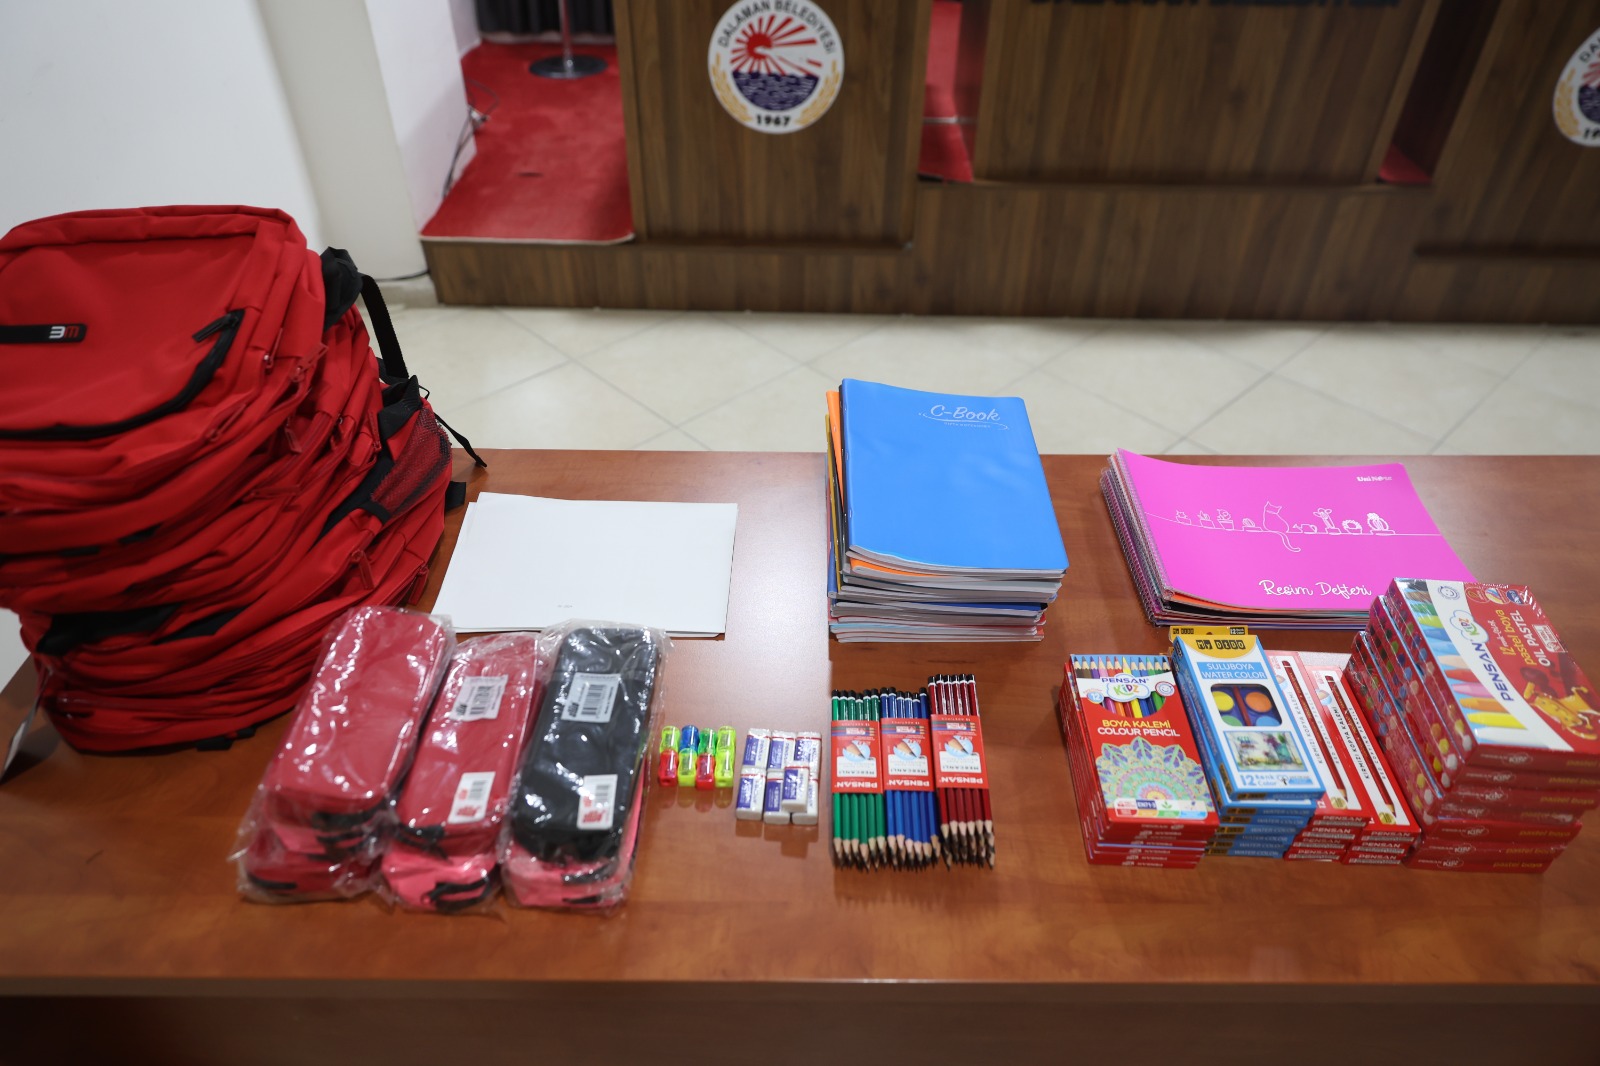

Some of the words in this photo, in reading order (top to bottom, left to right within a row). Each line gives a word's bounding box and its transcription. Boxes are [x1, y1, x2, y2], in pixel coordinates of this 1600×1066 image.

[718, 1, 771, 48] DALAMAN
[757, 115, 791, 126] 1967
[930, 404, 1001, 421] C-Book
[1259, 579, 1313, 596] Resim
[1315, 581, 1372, 599] Defteri
[1495, 608, 1516, 633] boya
[1509, 609, 1540, 647] PASTEL
[1507, 633, 1538, 666] pastel
[1533, 648, 1551, 667] OIL
[1202, 671, 1233, 679] WATER
[1471, 642, 1514, 701] PENSAN
[1097, 727, 1142, 736] COLOUR
[1143, 728, 1181, 737] PENCIL
[1102, 719, 1131, 728] BOYA
[1344, 731, 1358, 752] KOPYA
[888, 779, 930, 787] PENSAN
[940, 776, 984, 784] PENSAN
[1240, 774, 1257, 786] 12
